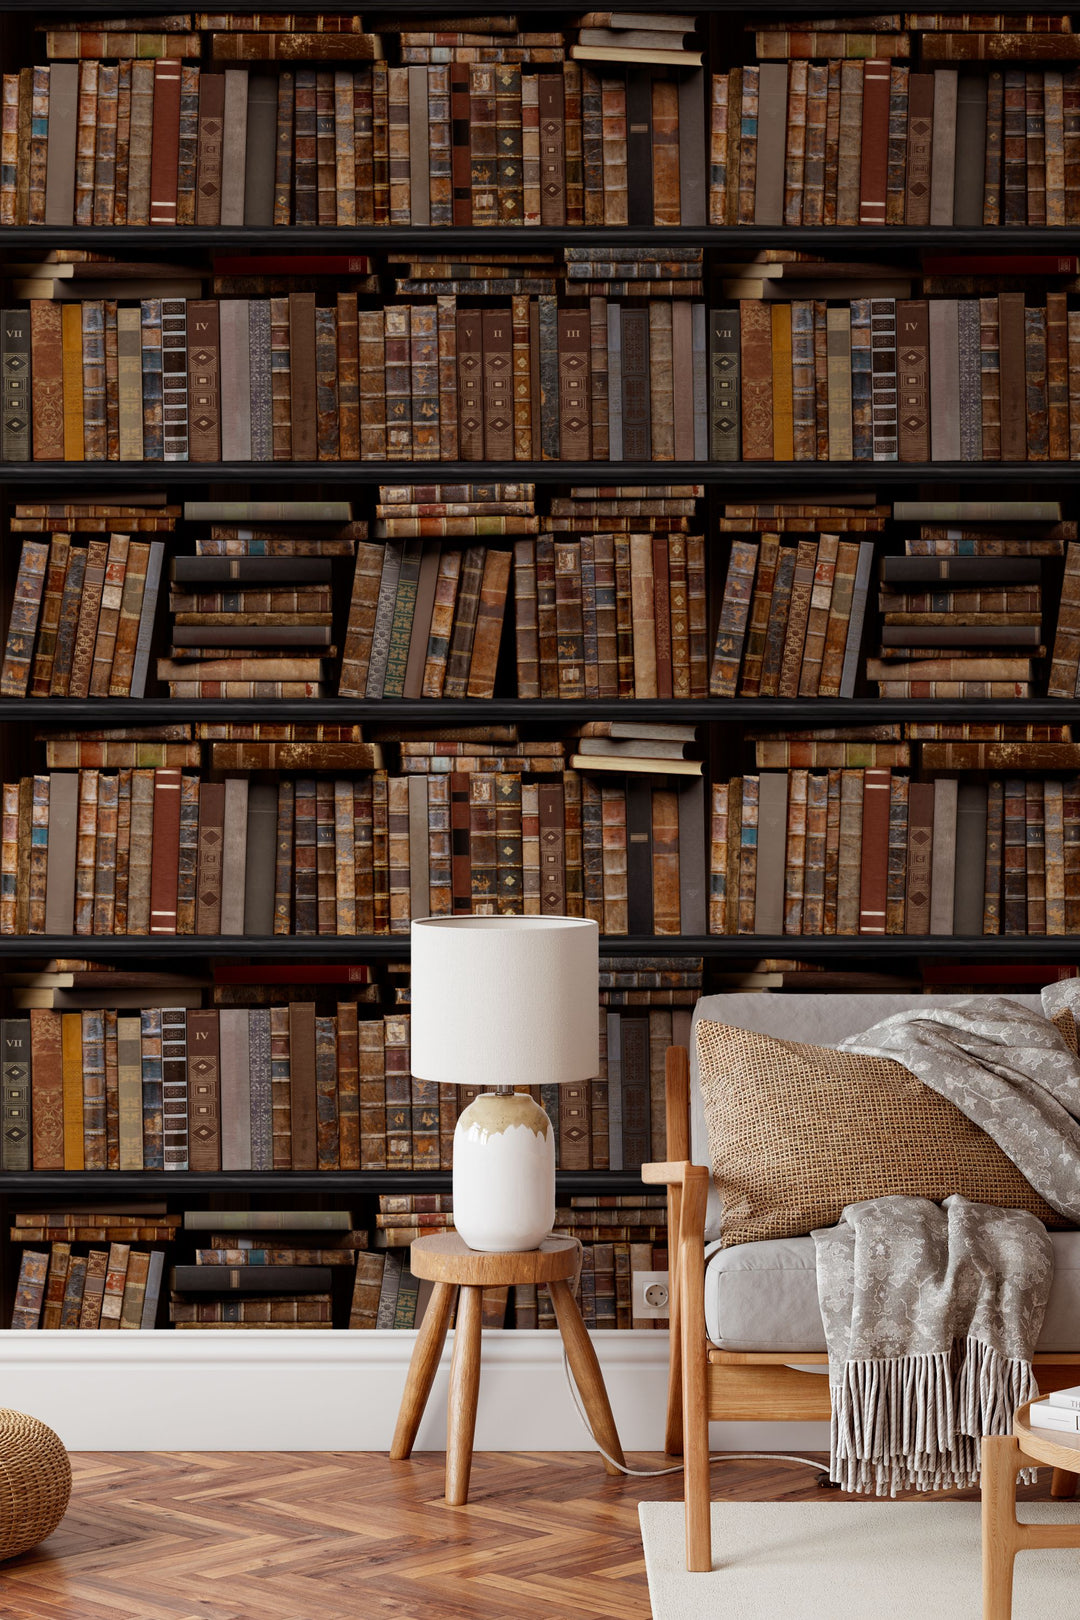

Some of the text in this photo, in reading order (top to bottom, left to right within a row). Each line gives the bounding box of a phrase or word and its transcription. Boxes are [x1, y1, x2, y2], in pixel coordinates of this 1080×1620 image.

[195, 322, 209, 331] IV
[904, 322, 918, 331] IV
[6, 330, 23, 338] VII
[465, 329, 473, 337] V
[493, 329, 503, 338] II
[566, 329, 581, 338] III
[715, 330, 732, 338] VII
[195, 1031, 209, 1040] IV
[6, 1039, 23, 1047] VII
